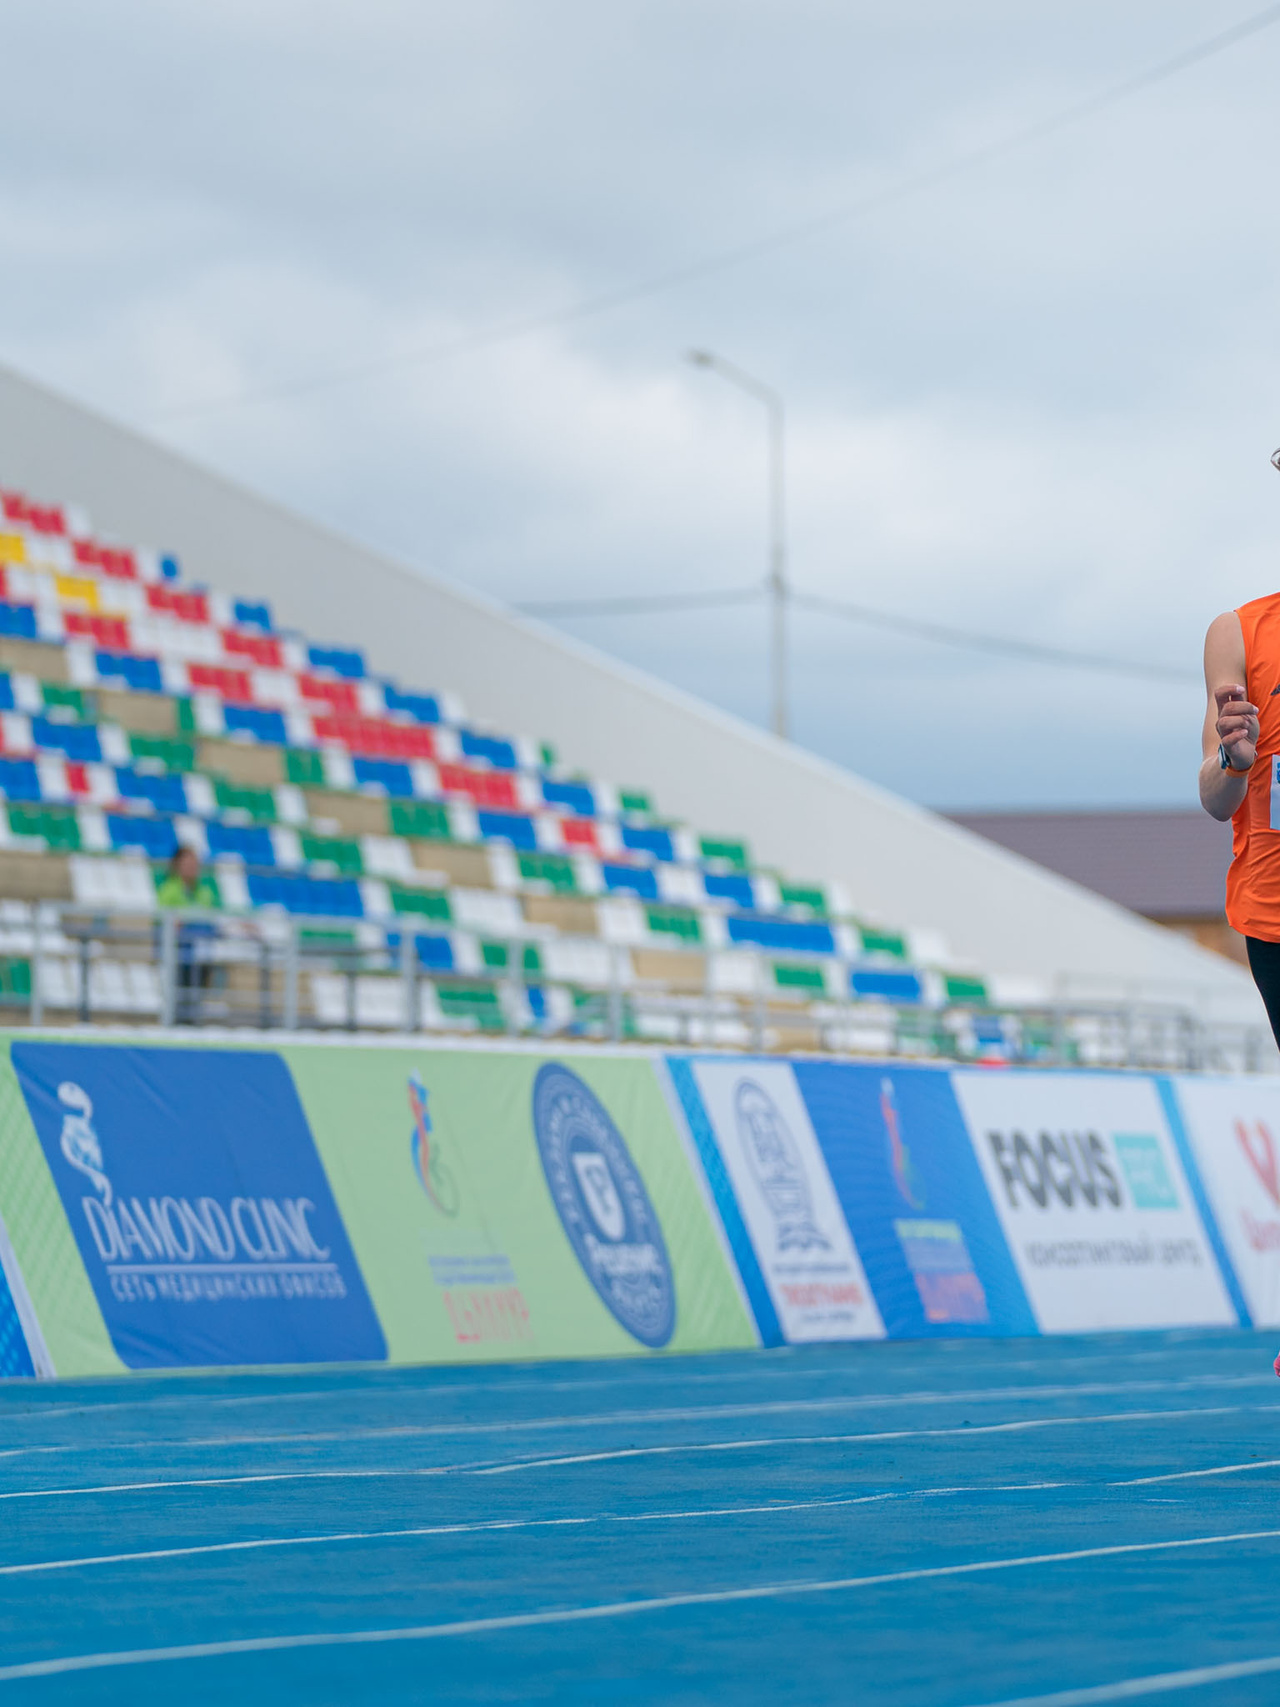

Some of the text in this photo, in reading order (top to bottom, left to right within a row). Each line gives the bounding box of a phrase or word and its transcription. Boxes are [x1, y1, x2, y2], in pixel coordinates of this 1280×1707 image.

[985, 1130, 1122, 1209] FOCUS
[82, 1196, 331, 1262] DIAMOND CLINIC
